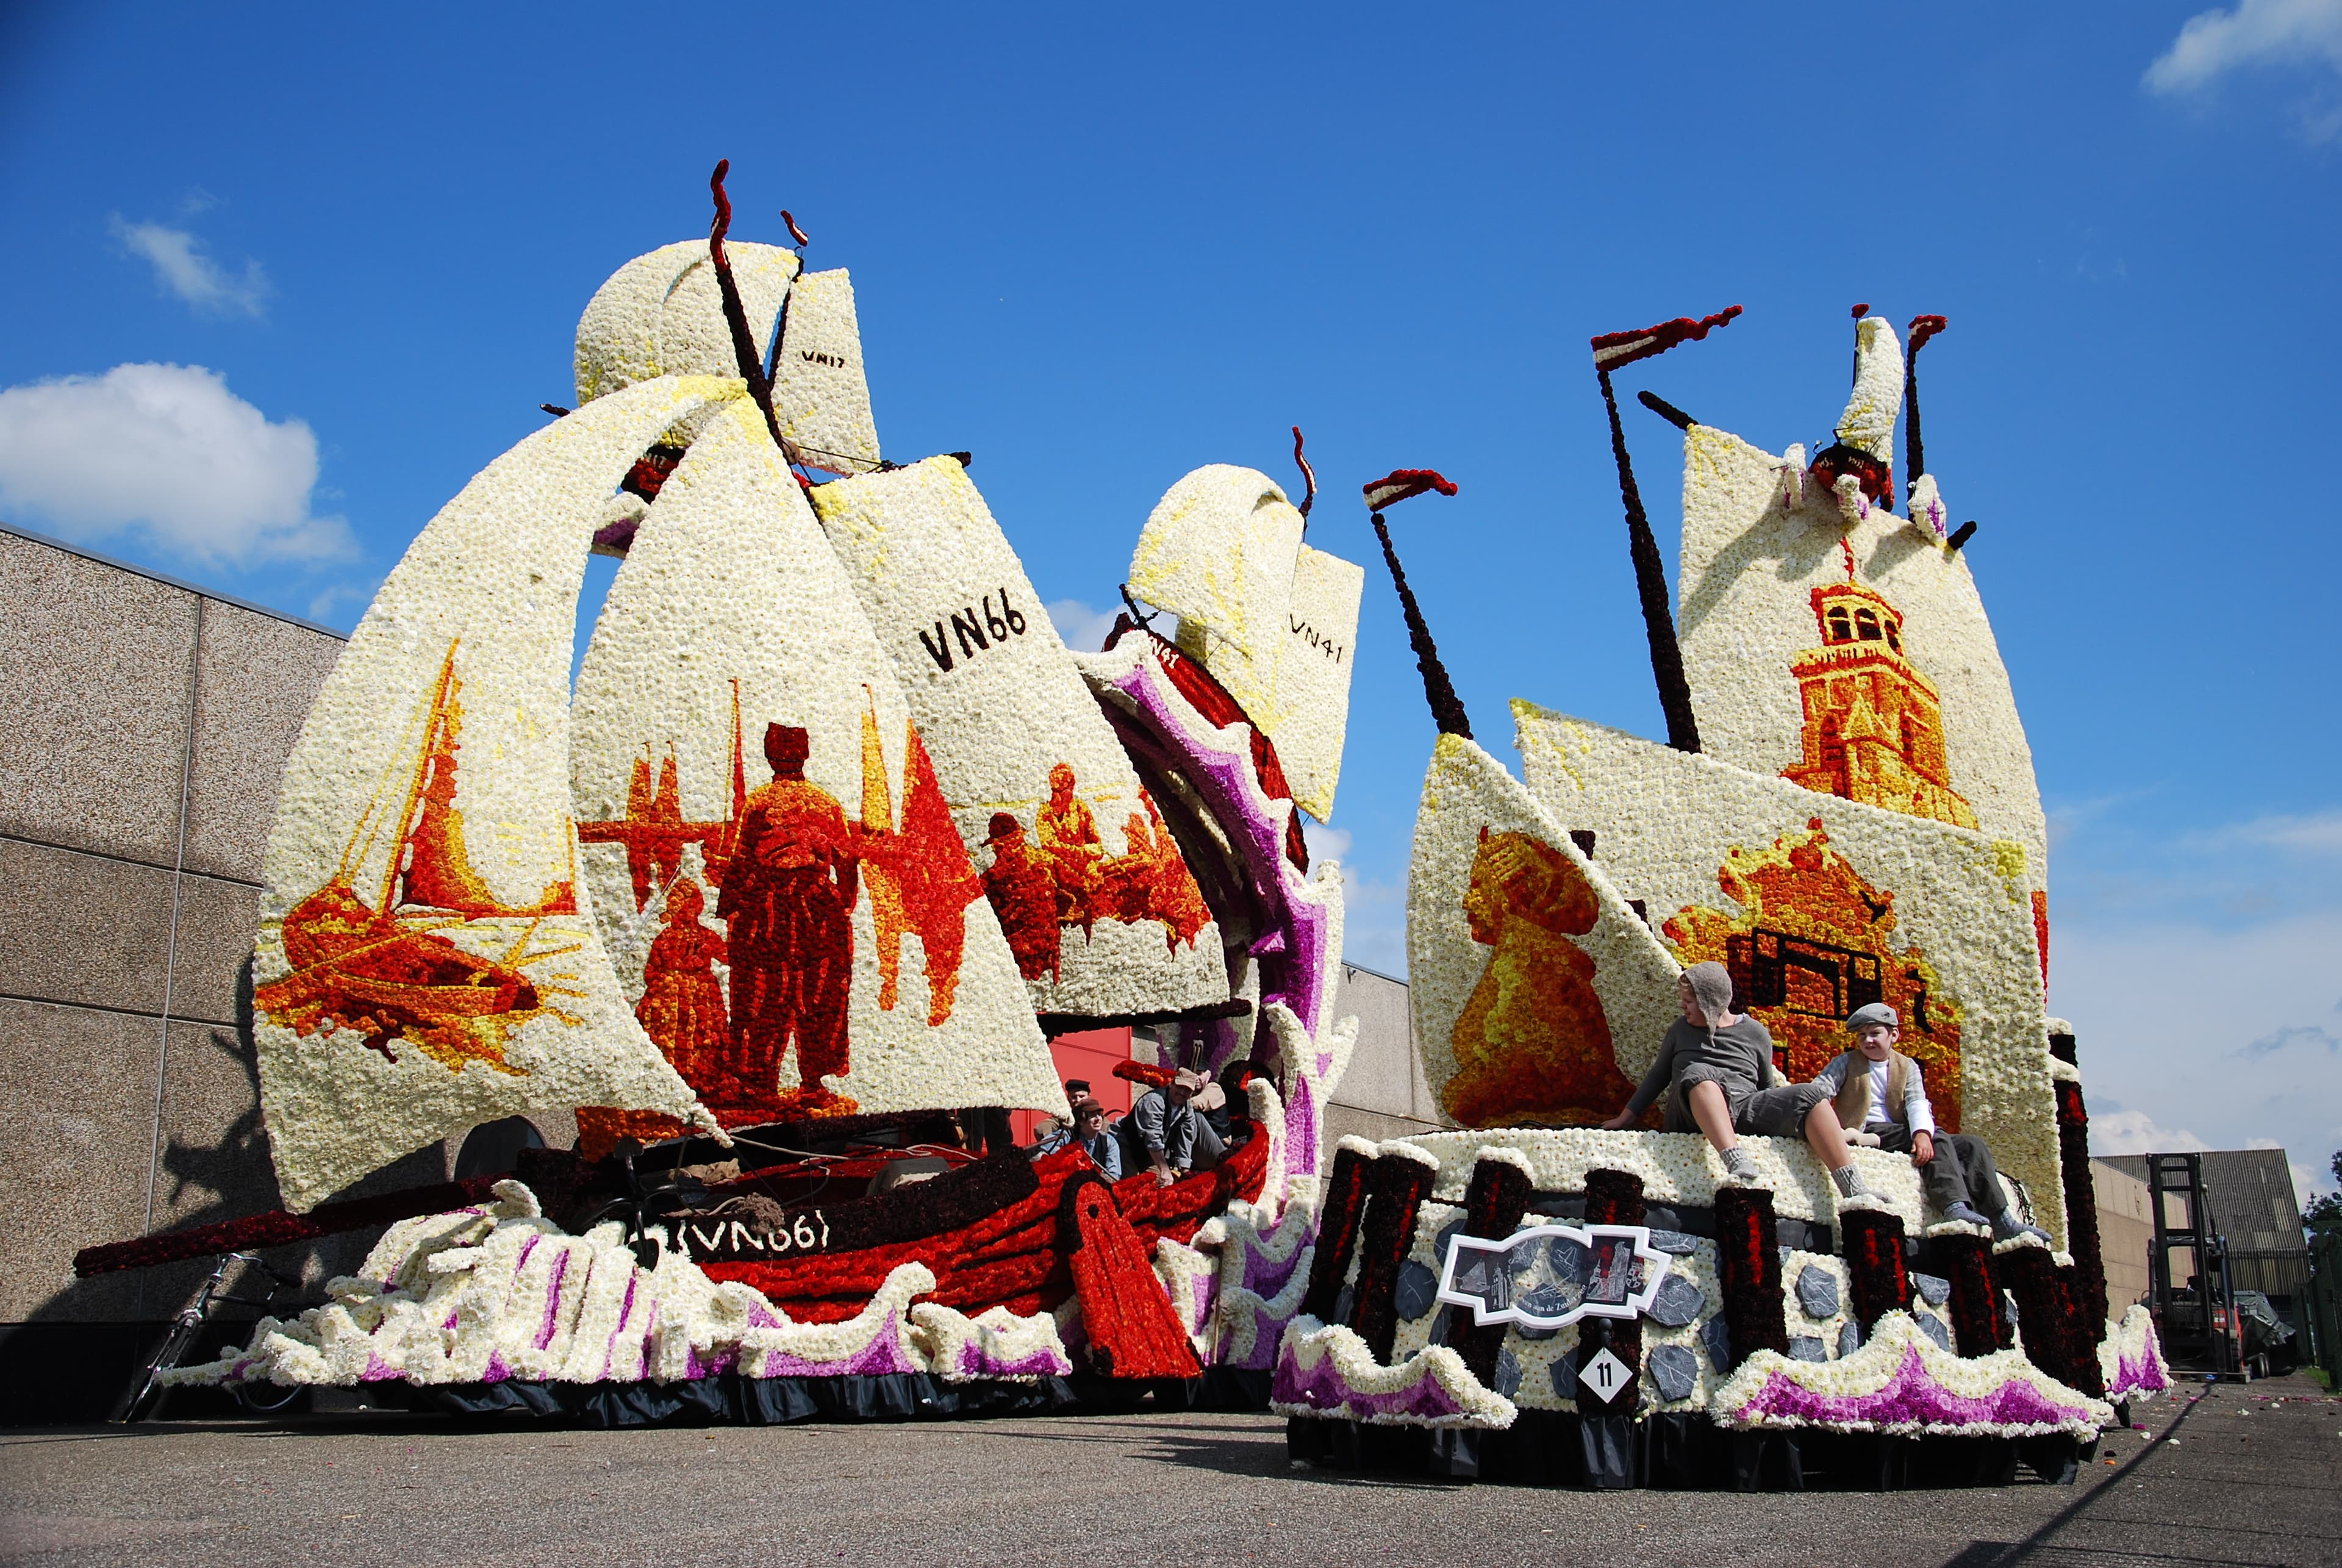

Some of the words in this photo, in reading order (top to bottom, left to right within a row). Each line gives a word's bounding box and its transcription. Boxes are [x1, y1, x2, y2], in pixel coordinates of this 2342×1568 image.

[801, 350, 845, 368] VN17
[919, 587, 1026, 672] VN66
[1289, 613, 1342, 664] VN41
[1148, 635, 1180, 669] N41
[1597, 1362, 1612, 1387] 11
